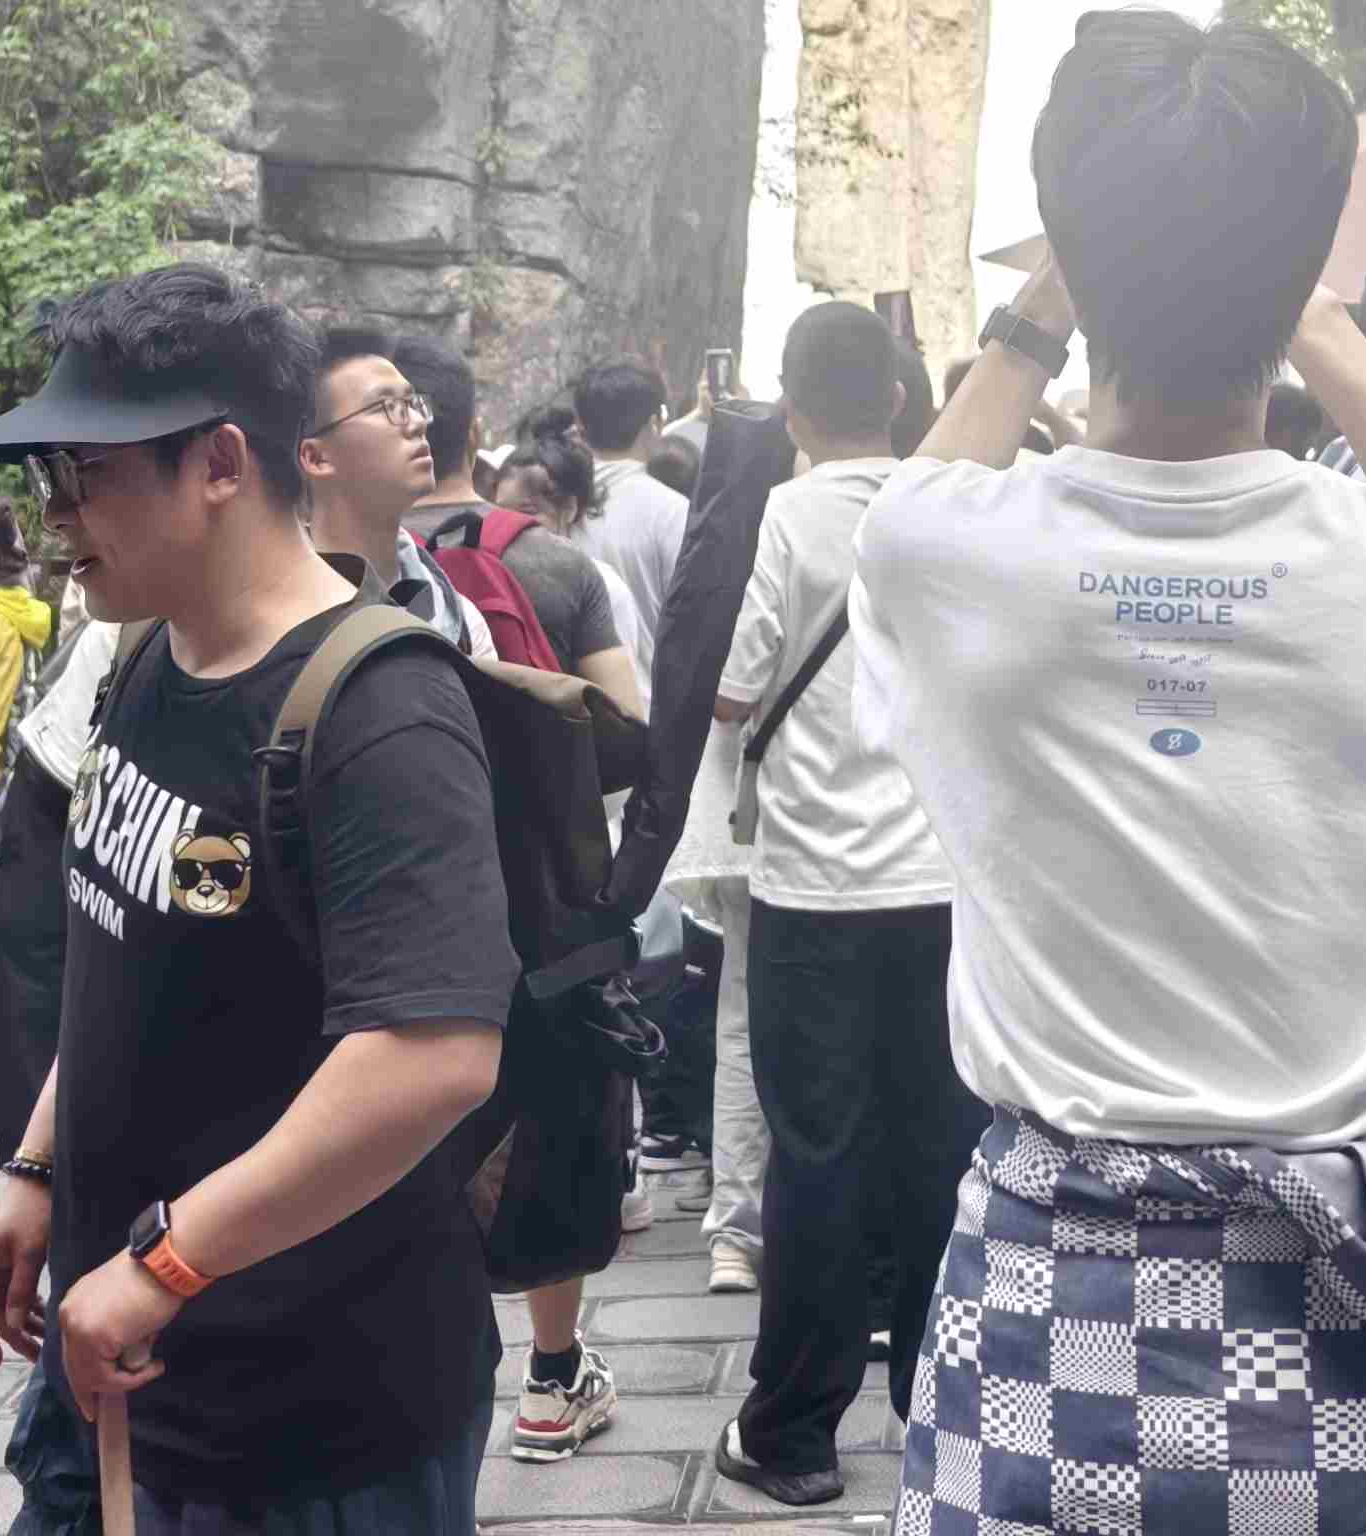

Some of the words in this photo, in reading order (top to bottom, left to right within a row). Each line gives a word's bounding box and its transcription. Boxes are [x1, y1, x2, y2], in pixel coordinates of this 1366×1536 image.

[1078, 570, 1269, 601] DANGEROUS
[1114, 601, 1234, 626] PEOPLE
[69, 866, 125, 942] SWIM
